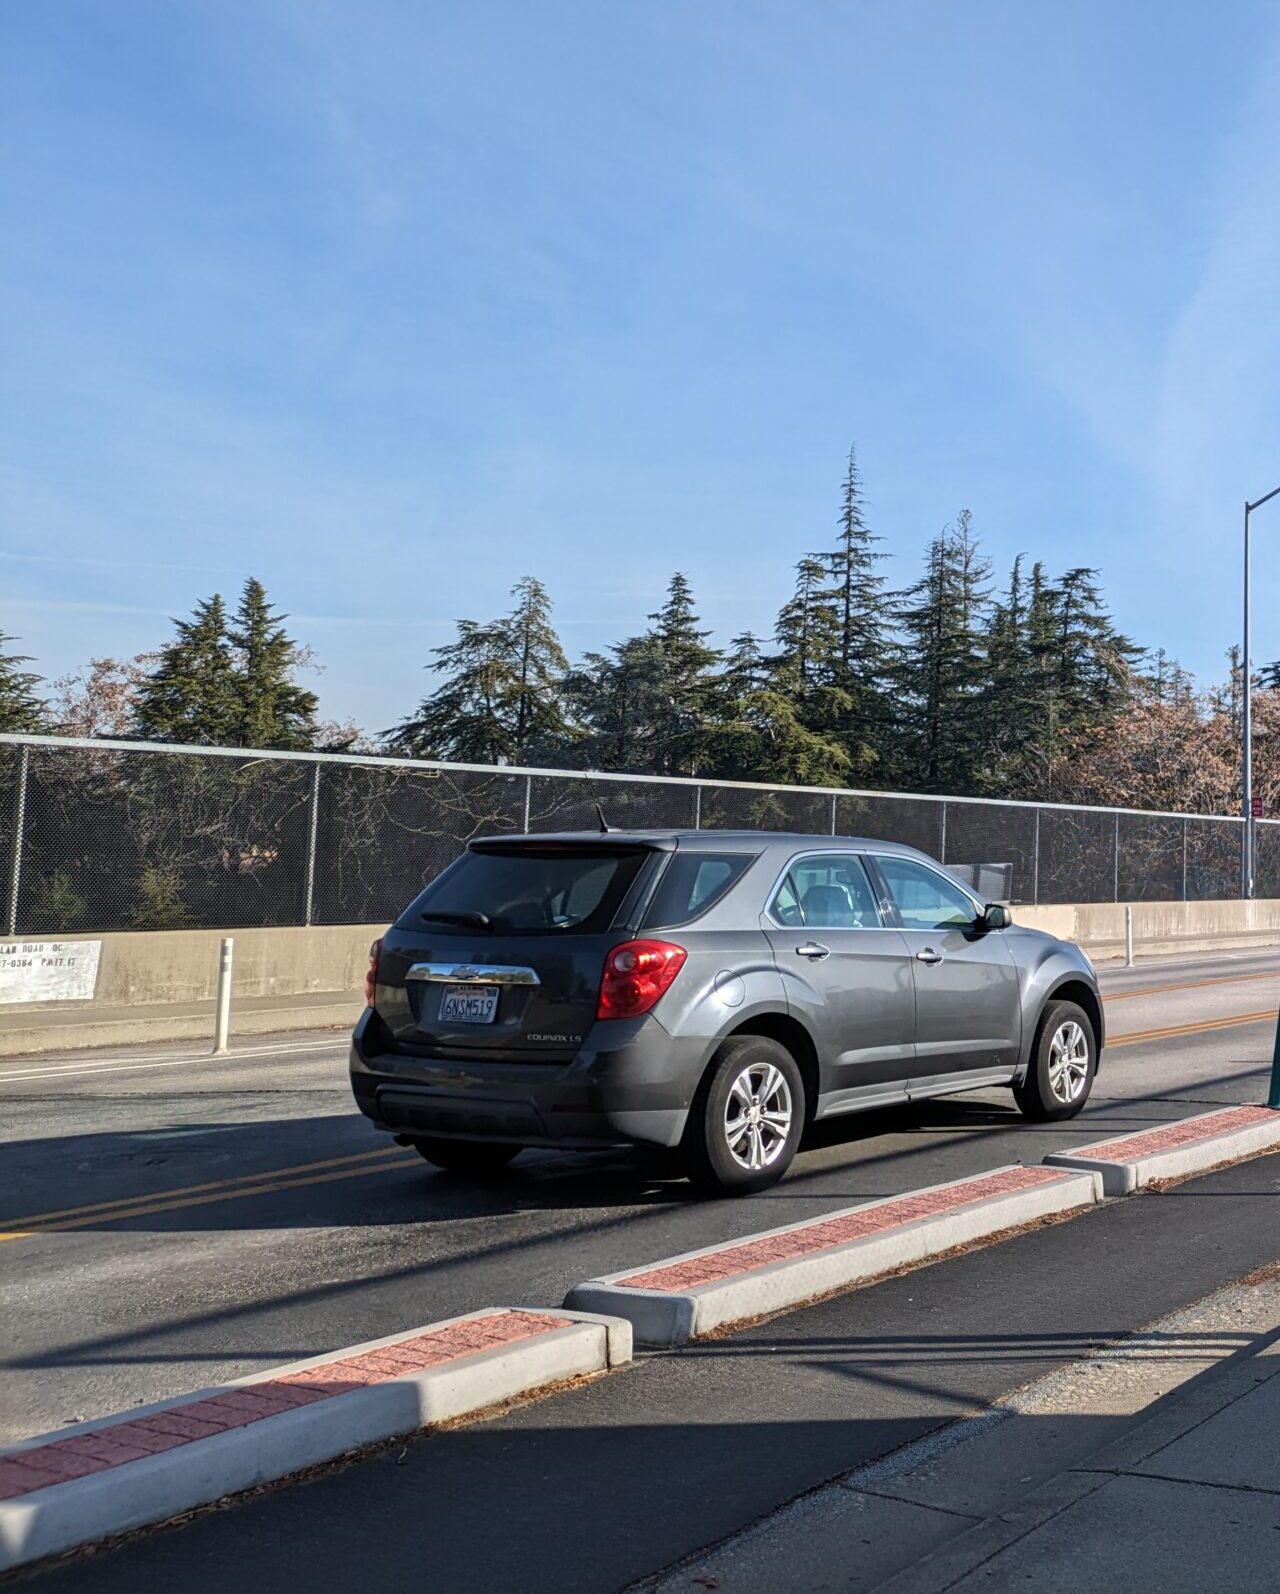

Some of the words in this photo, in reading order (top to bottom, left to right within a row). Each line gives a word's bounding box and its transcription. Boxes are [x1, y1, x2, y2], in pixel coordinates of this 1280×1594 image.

[22, 944, 44, 953] ROAD
[0, 958, 33, 968] 7-0384
[445, 999, 493, 1017] 6NSM519
[527, 1033, 568, 1042] EQUINOX
